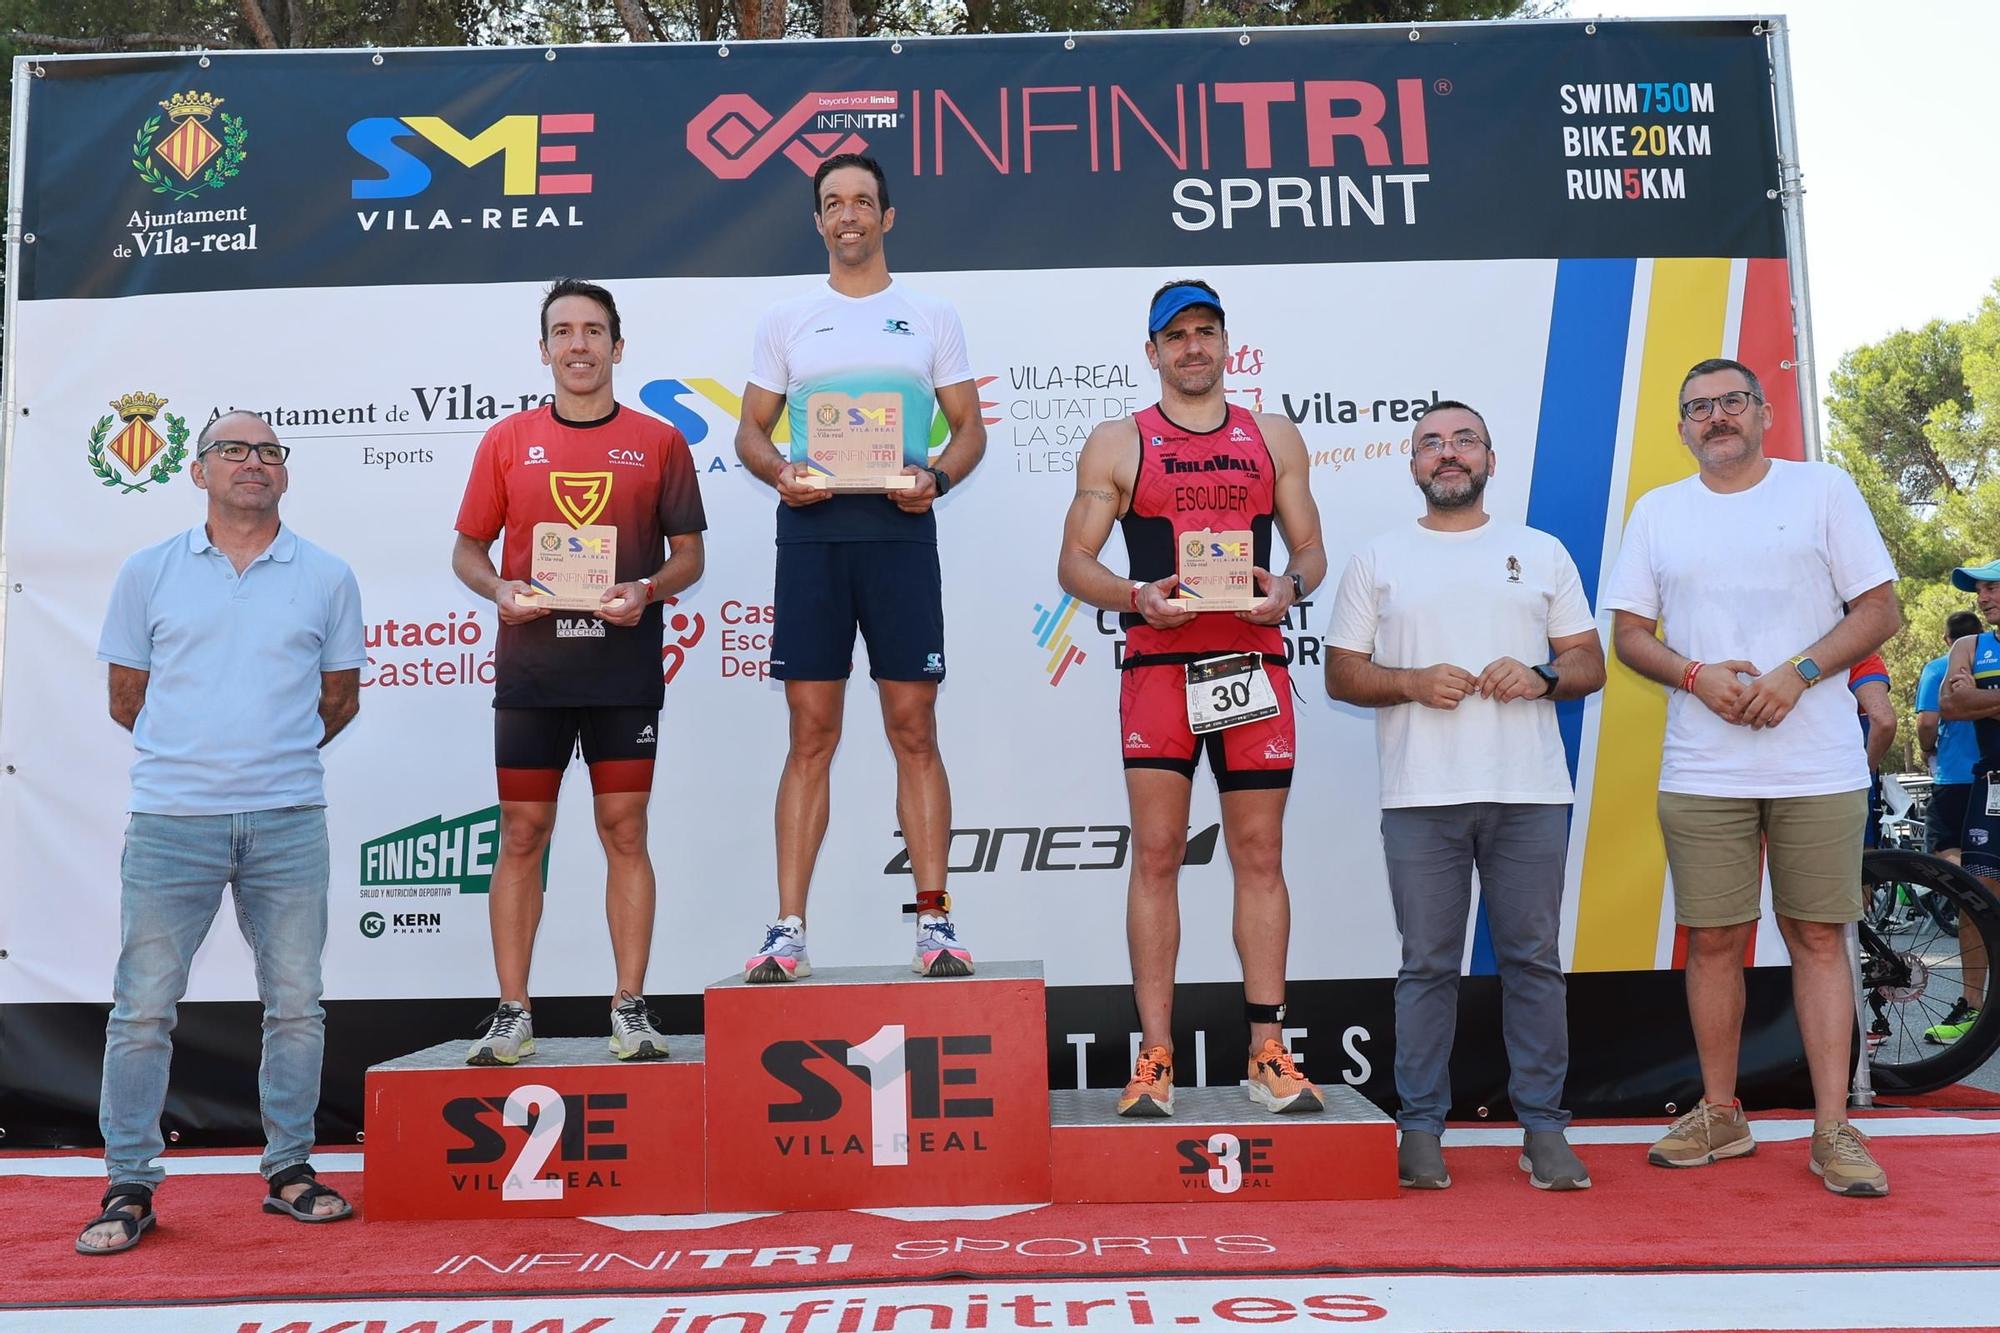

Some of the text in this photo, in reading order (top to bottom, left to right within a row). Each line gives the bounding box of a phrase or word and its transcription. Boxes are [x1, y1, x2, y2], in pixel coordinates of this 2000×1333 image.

[818, 95, 896, 107] beyond your limits
[817, 113, 898, 129] INFINITRI
[346, 113, 595, 200] SME
[1171, 173, 1431, 232] SPRINT
[126, 206, 248, 232] Ajuntament
[357, 206, 585, 232] VILA-REAL
[112, 223, 258, 258] de Vila-real
[1009, 364, 1139, 391] VILA-REAL
[206, 383, 556, 430] Antament de Vila-re
[847, 408, 897, 426] SME
[1010, 397, 1137, 421] CIUTAT DE
[1013, 426, 1050, 447] LA
[362, 446, 434, 470] Esports
[1308, 447, 1356, 472] nça
[1175, 484, 1249, 513] ESCUDER
[568, 537, 611, 553] SME
[1210, 542, 1249, 557] SME
[556, 618, 604, 630] MAX
[720, 600, 776, 625] Cas
[364, 611, 482, 648] utació
[721, 629, 775, 651] Esc
[721, 656, 771, 682] Dep
[1211, 681, 1250, 712] 30
[366, 819, 500, 882] FINISHE
[360, 889, 379, 899] SALUD
[380, 889, 385, 898] Y
[418, 887, 452, 898] DEPORTIVA
[393, 913, 441, 926] KERN
[846, 1024, 909, 1167] 1
[502, 1084, 567, 1201] 2
[1207, 1133, 1242, 1194] 3
[1181, 1178, 1272, 1189] VILEAL
[432, 1234, 1277, 1274] INFINITRI SPORTS
[235, 1291, 1388, 1333] infinitri.es
